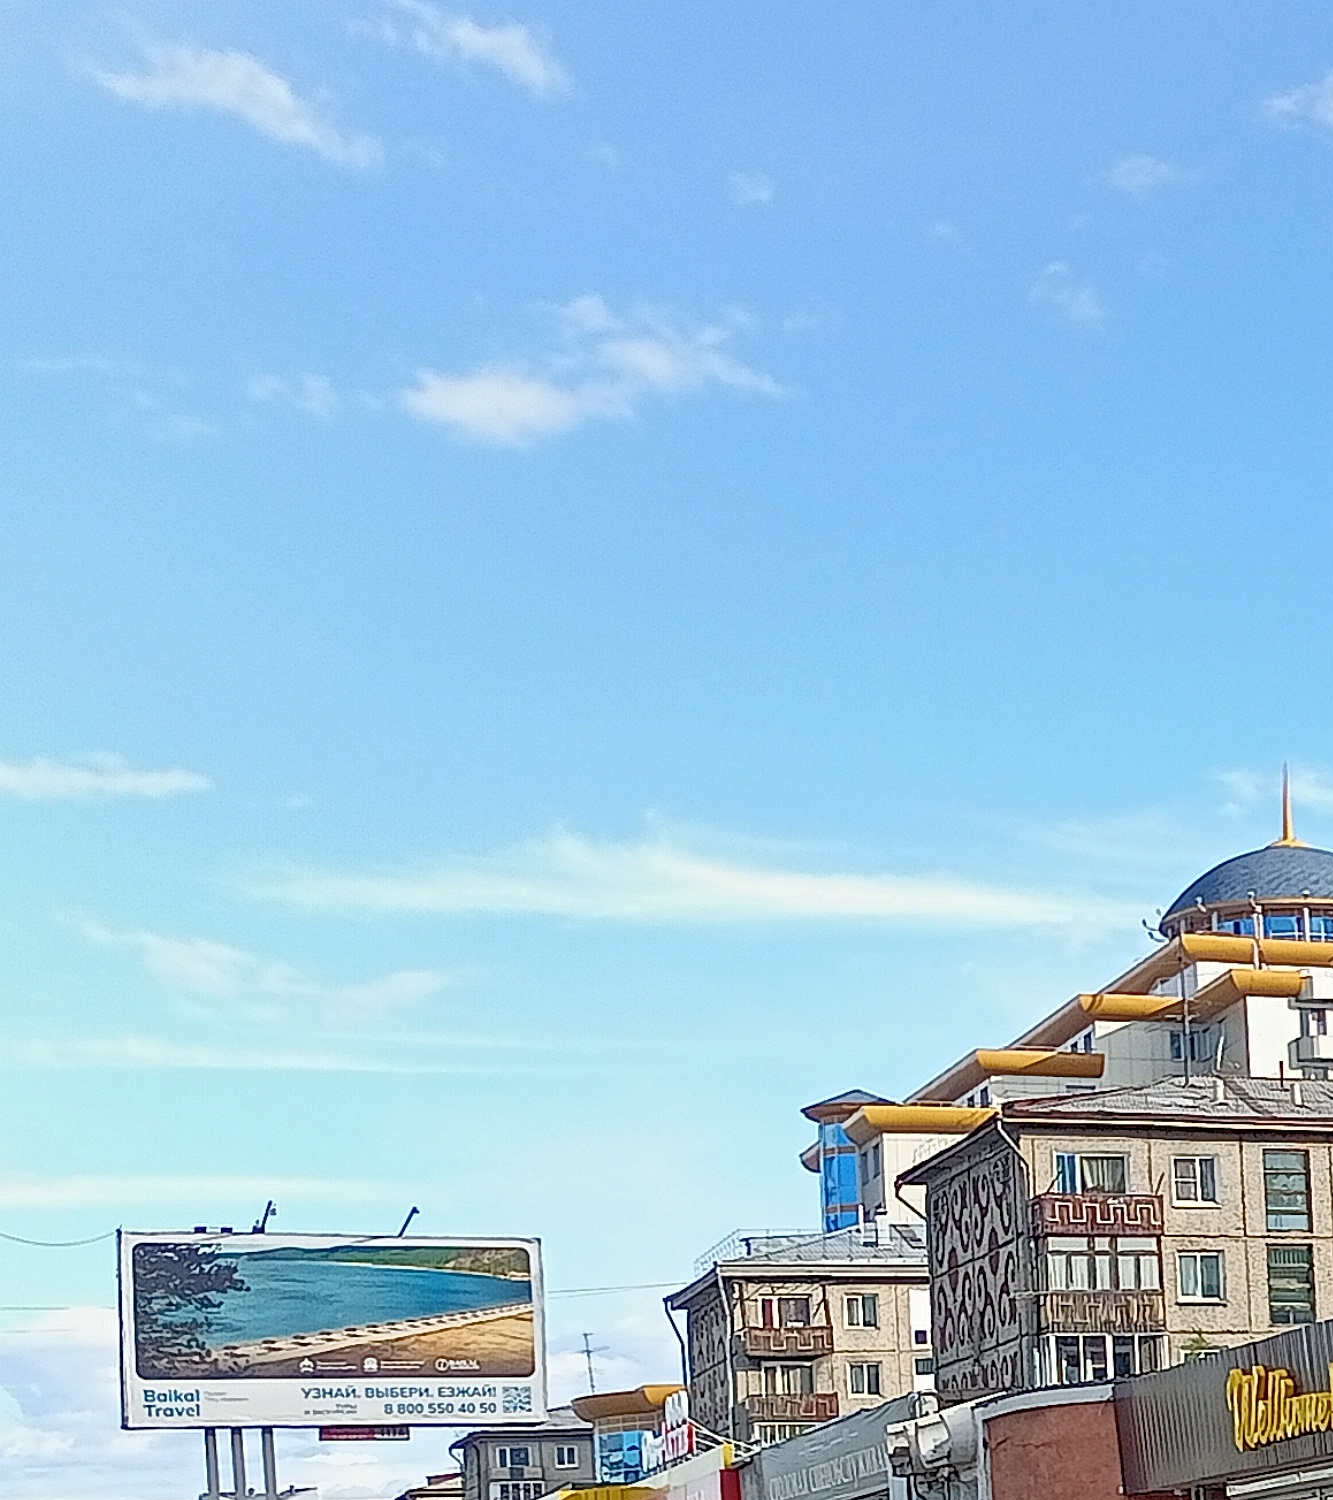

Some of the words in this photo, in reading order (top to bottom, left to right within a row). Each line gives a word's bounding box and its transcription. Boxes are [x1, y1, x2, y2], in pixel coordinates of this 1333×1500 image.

[143, 1389, 200, 1403] Baikal
[301, 1385, 362, 1399] УЗНАЙ.
[365, 1386, 434, 1398] ВЫБЕРИ.
[437, 1384, 497, 1398] ЕЗЖАЙ!
[143, 1404, 200, 1417] Travel
[383, 1403, 394, 1415] 8
[397, 1403, 424, 1415] 800
[427, 1402, 455, 1414] 550
[458, 1402, 476, 1414] 40
[479, 1402, 497, 1414] 50
